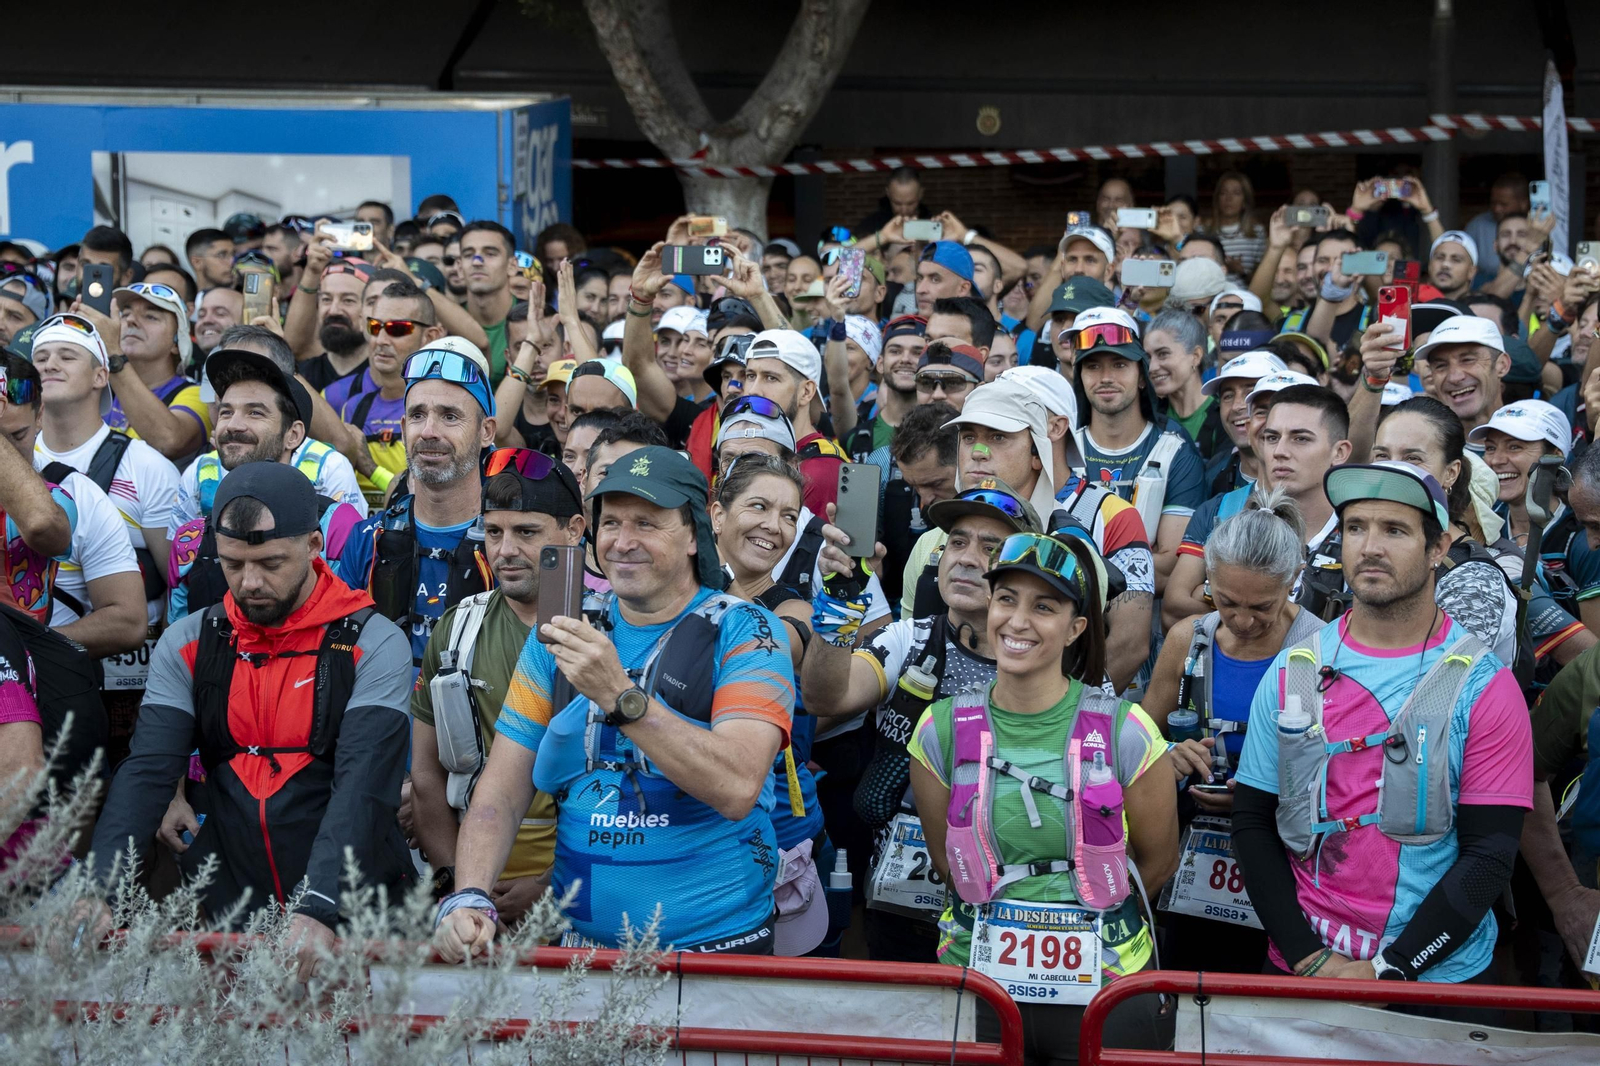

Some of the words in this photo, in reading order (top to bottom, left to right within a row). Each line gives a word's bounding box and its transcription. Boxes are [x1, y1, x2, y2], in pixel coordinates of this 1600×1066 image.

[116, 676, 143, 687] asisa
[662, 672, 688, 691] EVADICT
[880, 721, 911, 745] MAX
[590, 811, 670, 828] muebles
[953, 846, 970, 883] AONIJIE
[1102, 862, 1117, 897] AONIJIE
[1233, 898, 1252, 907] MAM
[997, 906, 1011, 920] LA
[1204, 904, 1239, 920] asisa
[998, 931, 1082, 970] 2198
[1410, 931, 1451, 969] KIPRUN
[1041, 973, 1077, 982] CABECILLA
[1008, 984, 1047, 998] asisa
